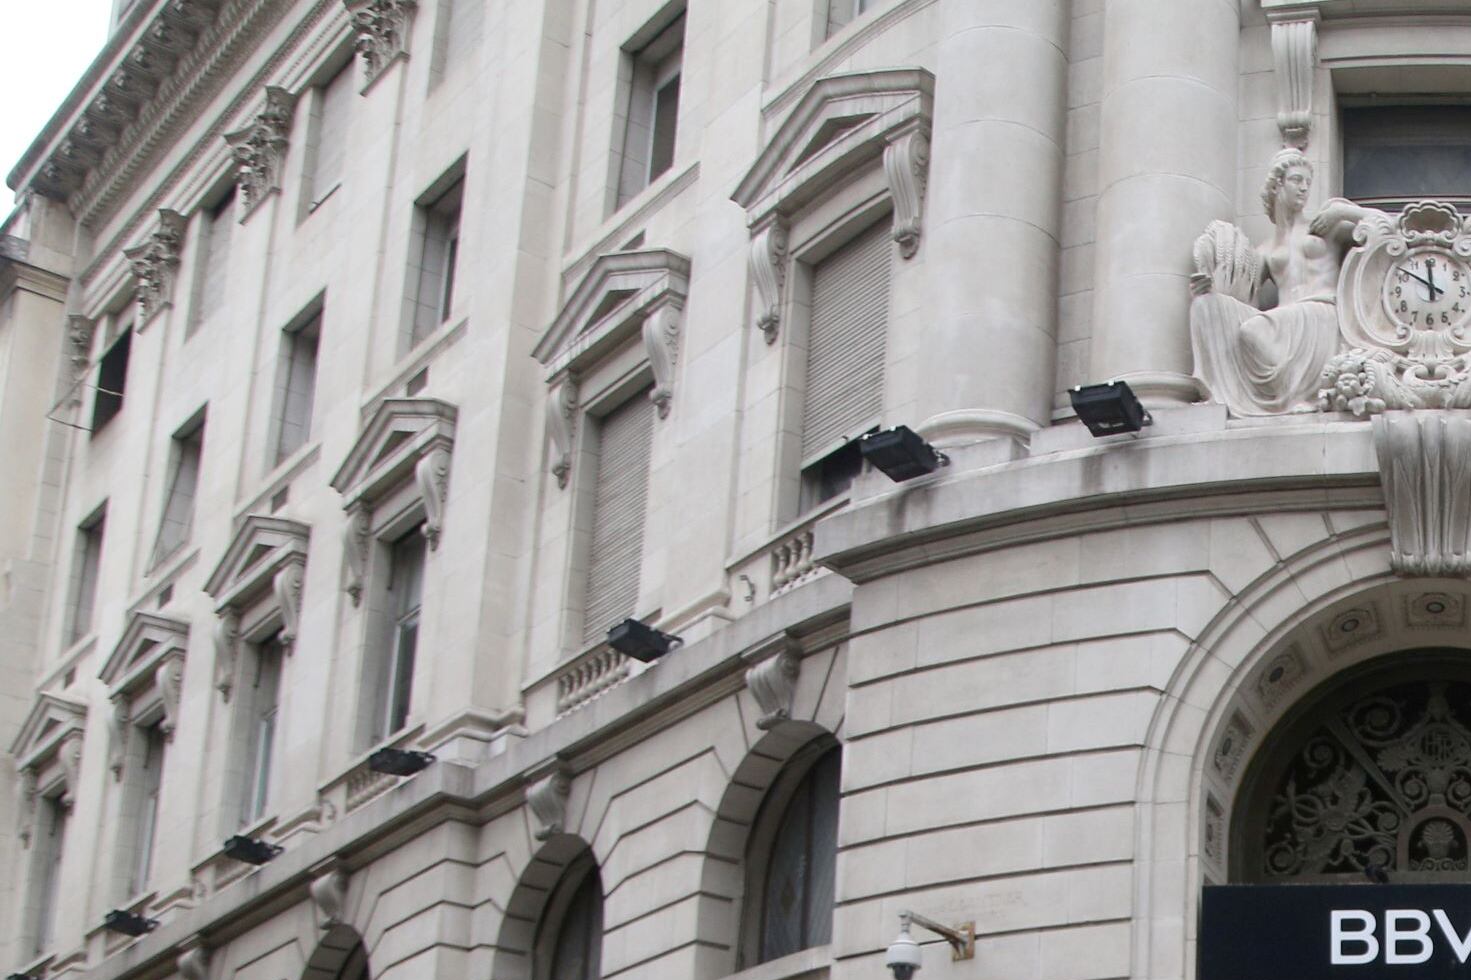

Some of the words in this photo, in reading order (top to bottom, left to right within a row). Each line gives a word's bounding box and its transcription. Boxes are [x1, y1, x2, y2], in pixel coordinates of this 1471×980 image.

[1394, 286, 1402, 298] 9
[1459, 286, 1466, 298] 3
[1400, 300, 1408, 313] 8
[1451, 302, 1460, 312] 4
[1411, 311, 1419, 323] 7
[1425, 313, 1434, 326] 6
[1441, 311, 1449, 323] 5
